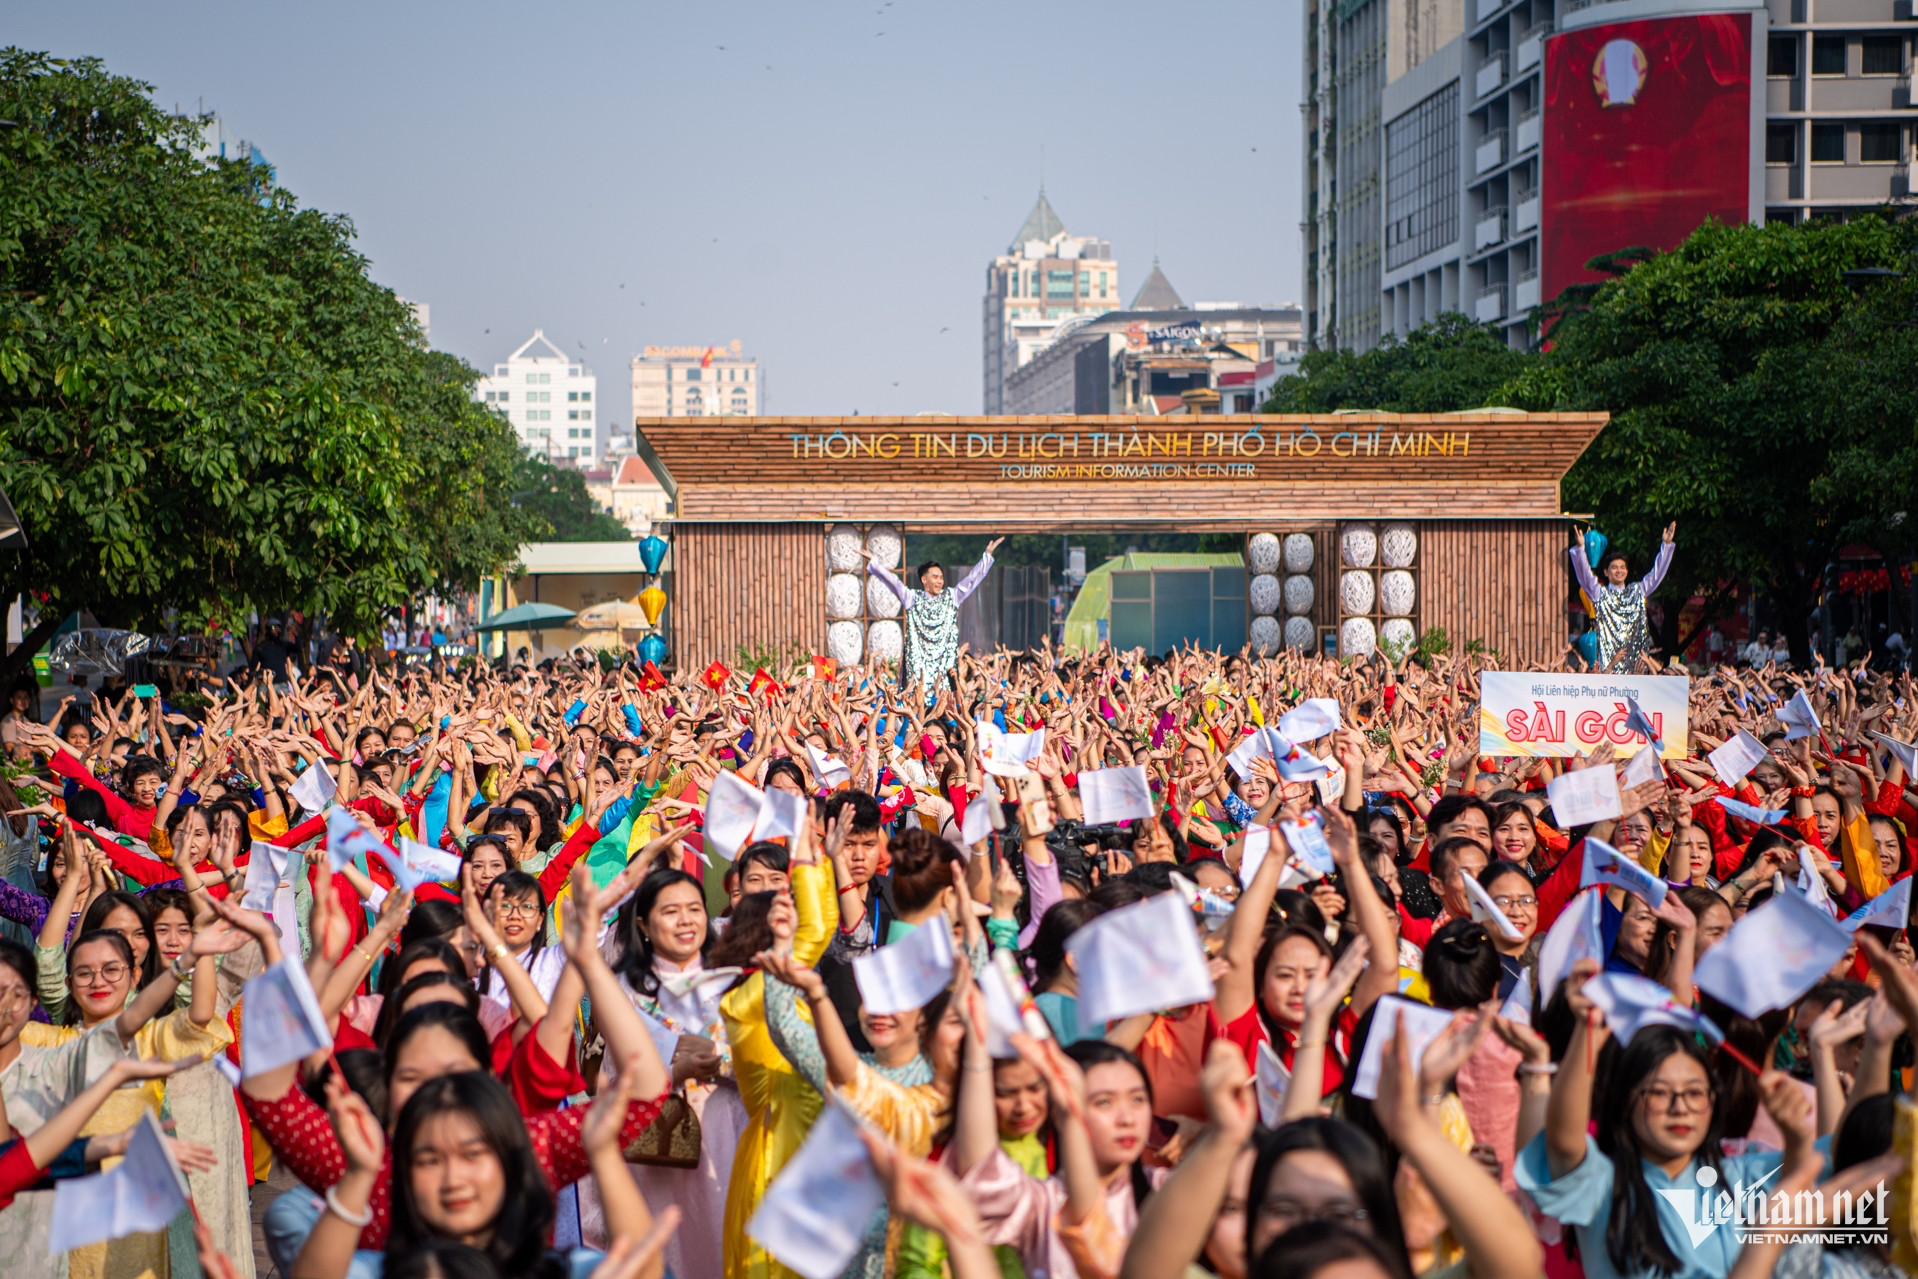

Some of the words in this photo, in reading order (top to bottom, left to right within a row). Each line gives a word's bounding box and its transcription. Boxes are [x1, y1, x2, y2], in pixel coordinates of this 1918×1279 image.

[788, 429, 901, 459] THÔNG
[909, 433, 956, 458] TIN
[966, 433, 1008, 458] DU
[1018, 433, 1079, 462] LỊCH
[1088, 425, 1192, 457] THÀNH
[1202, 423, 1266, 457] PHỐ
[1274, 423, 1322, 457] HỒ
[1331, 425, 1384, 457] CHÍ
[1388, 432, 1470, 457] MINH
[1000, 464, 1071, 479] TOURISM
[1075, 463, 1191, 479] INFORMATION
[1195, 463, 1256, 478] CENTER
[1531, 684, 1545, 697] Hội
[1545, 684, 1562, 696] Liên
[1562, 685, 1580, 698] hiệp
[1581, 686, 1596, 698] Phụ
[1597, 686, 1608, 697] nữ
[1505, 701, 1566, 743] SÀI
